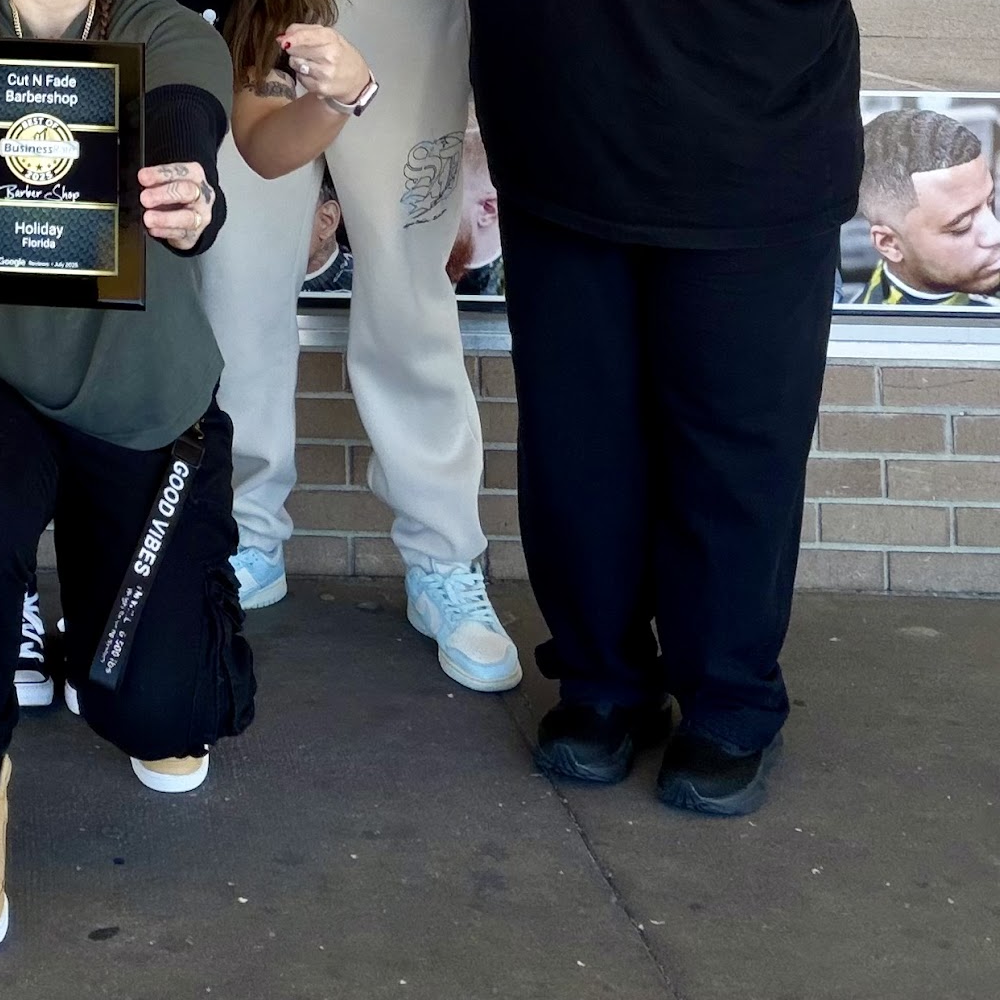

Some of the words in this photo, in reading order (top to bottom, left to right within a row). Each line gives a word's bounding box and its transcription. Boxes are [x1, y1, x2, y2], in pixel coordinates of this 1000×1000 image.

[7, 73, 29, 86] Cut
[32, 75, 42, 87] N
[45, 75, 76, 88] Fade
[5, 90, 78, 107] Barbershop
[21, 117, 44, 129] BEST
[45, 119, 58, 129] OF
[24, 171, 53, 181] 2025
[44, 184, 80, 202] Shop
[14, 222, 63, 239] Holiday
[22, 237, 56, 248] Florida
[158, 460, 190, 518] GOOD
[133, 518, 170, 577] VIBES
